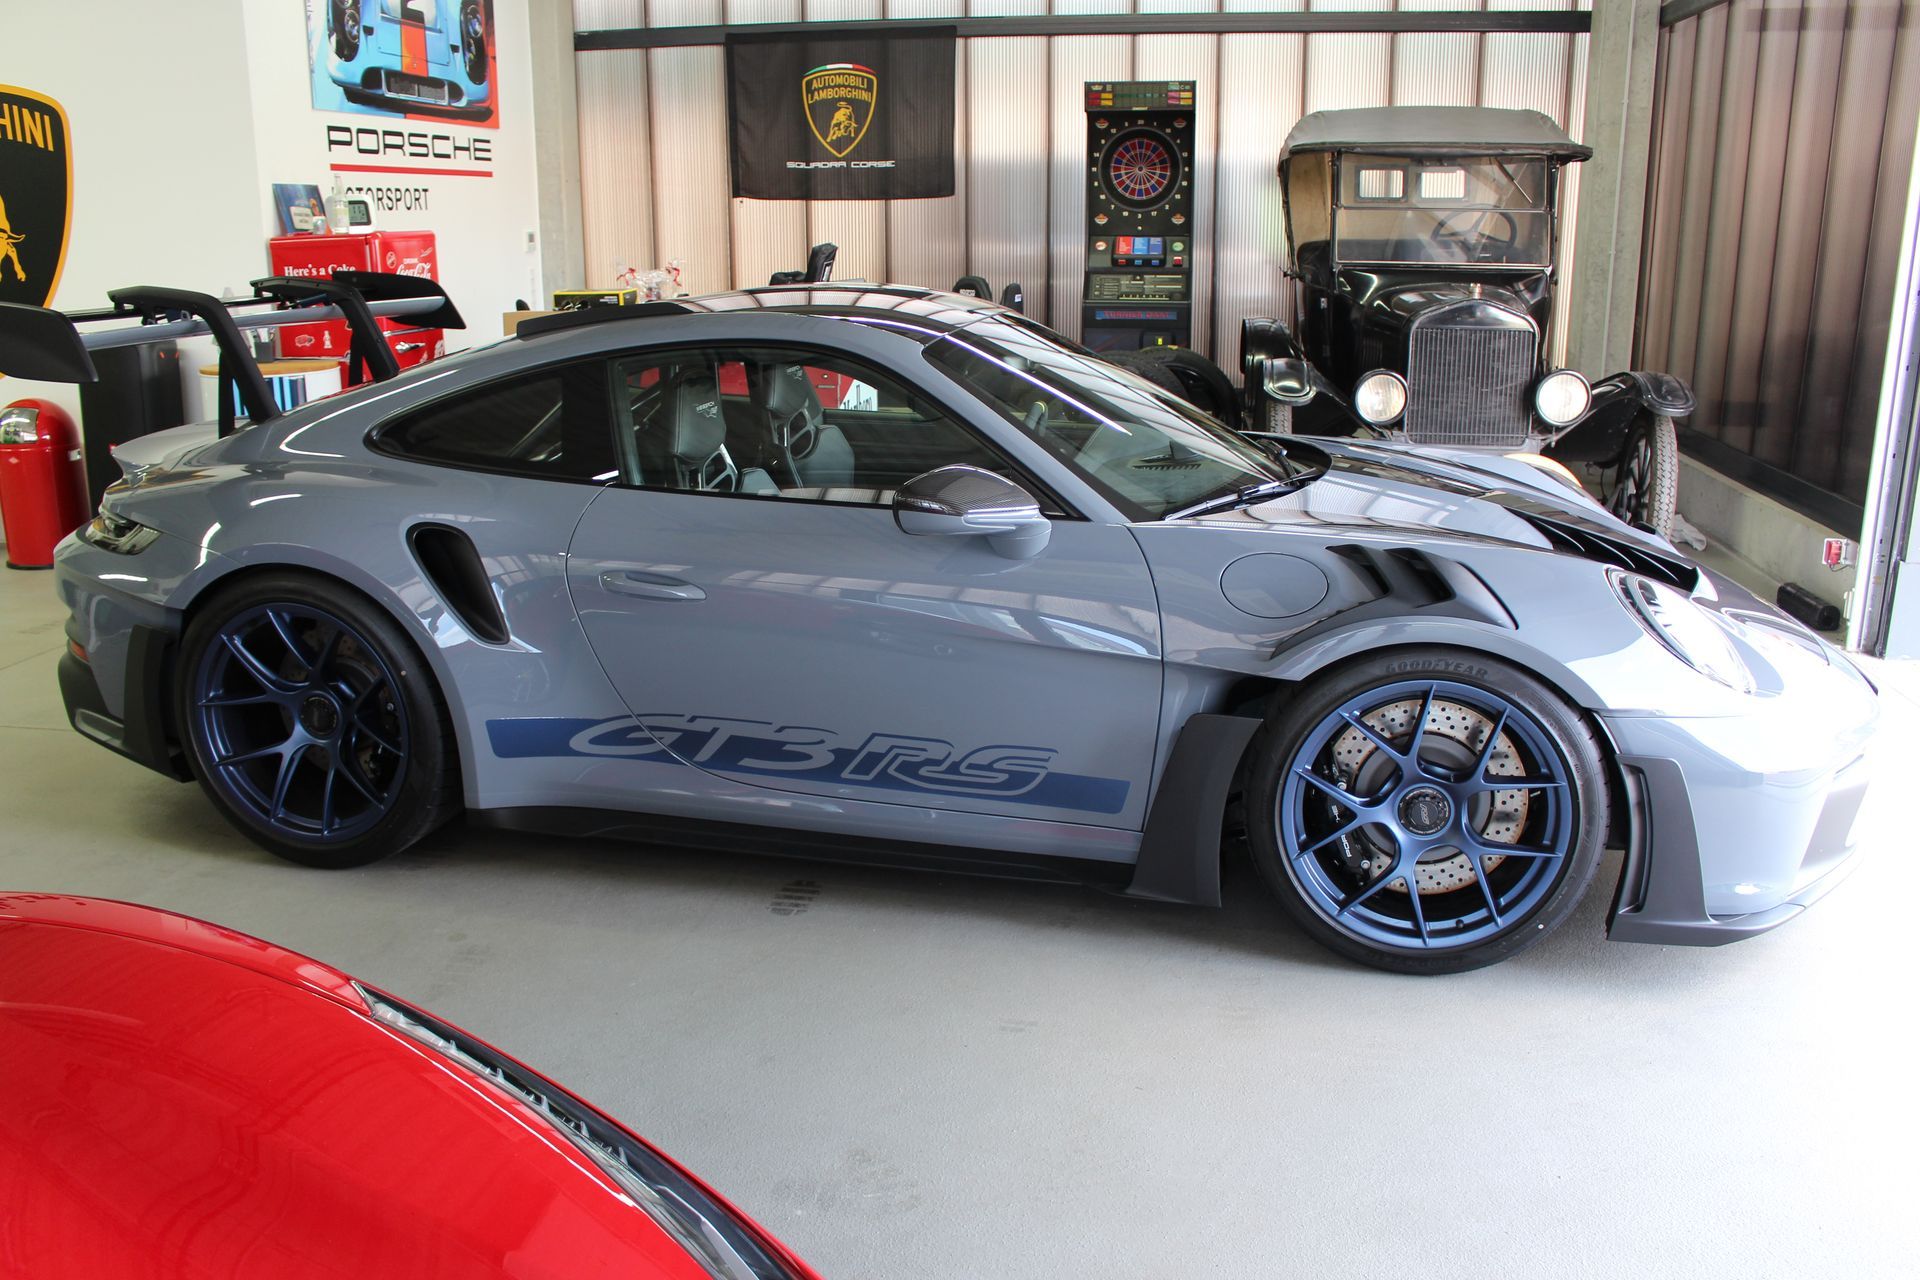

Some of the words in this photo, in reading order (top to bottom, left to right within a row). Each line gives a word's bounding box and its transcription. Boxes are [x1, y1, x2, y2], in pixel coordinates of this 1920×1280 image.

[811, 75, 868, 90] AUTOMOBILI
[807, 87, 872, 104] LAMBORGHINI
[327, 125, 493, 162] PORSCHE
[786, 161, 847, 169] SQUADRA
[850, 160, 896, 168] CORSE
[332, 186, 430, 211] ORSPORT
[284, 263, 318, 278] Here's
[319, 267, 327, 276] a
[1385, 659, 1489, 680] GOODYEAR
